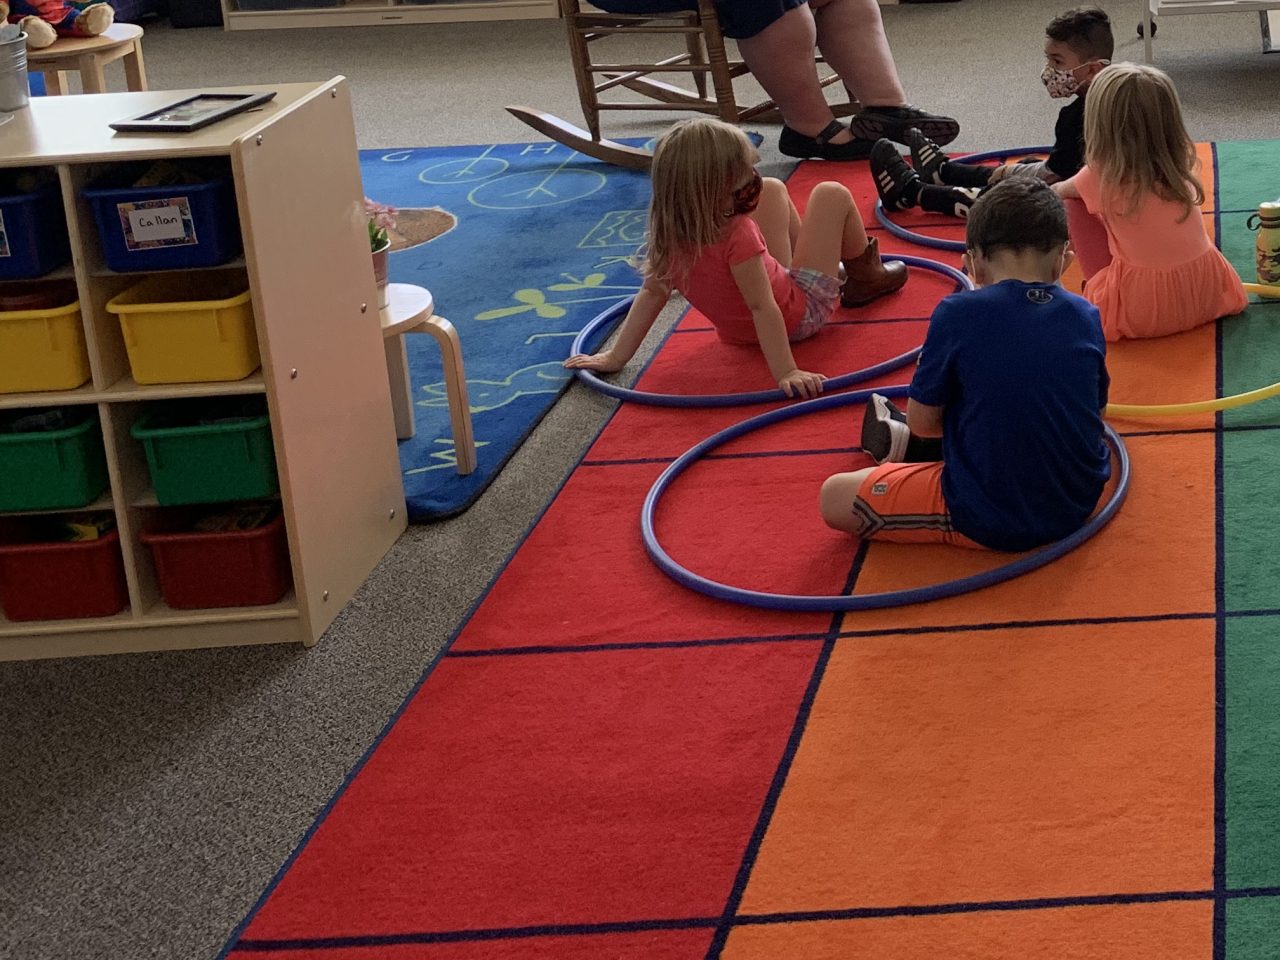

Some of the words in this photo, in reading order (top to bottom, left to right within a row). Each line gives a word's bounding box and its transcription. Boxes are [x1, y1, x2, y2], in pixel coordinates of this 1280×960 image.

[381, 150, 414, 162] G
[519, 144, 553, 156] H
[138, 215, 179, 228] Callan
